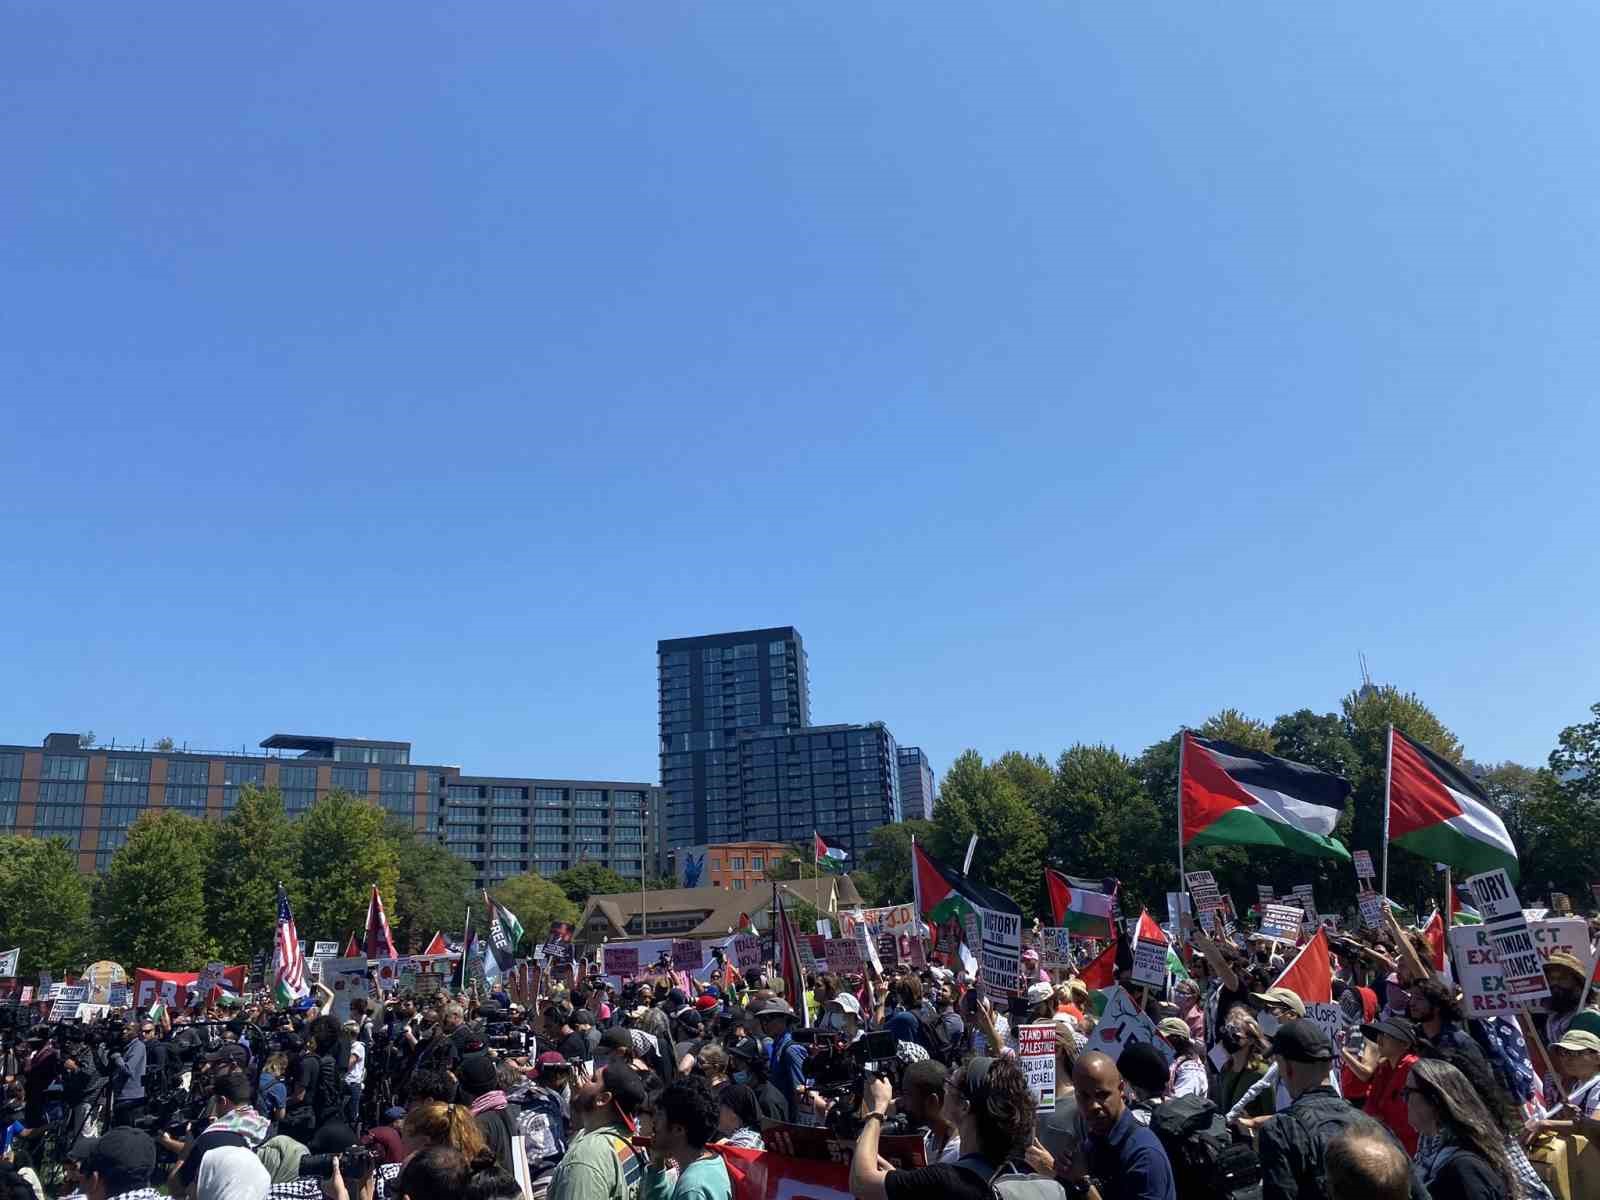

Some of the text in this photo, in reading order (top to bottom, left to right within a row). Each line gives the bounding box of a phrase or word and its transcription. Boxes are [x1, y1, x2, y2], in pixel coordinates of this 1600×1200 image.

[1472, 873, 1510, 903] TORY
[490, 919, 508, 949] FREE
[983, 911, 1018, 935] VICTORY
[1494, 932, 1533, 955] TINIAN
[1503, 953, 1541, 978] TANCE
[983, 967, 1018, 989] TANCE
[1315, 1002, 1337, 1023] COPS
[1020, 1029, 1056, 1041] STAND WITH
[1034, 1060, 1043, 1070] US
[1043, 1059, 1054, 1069] AID
